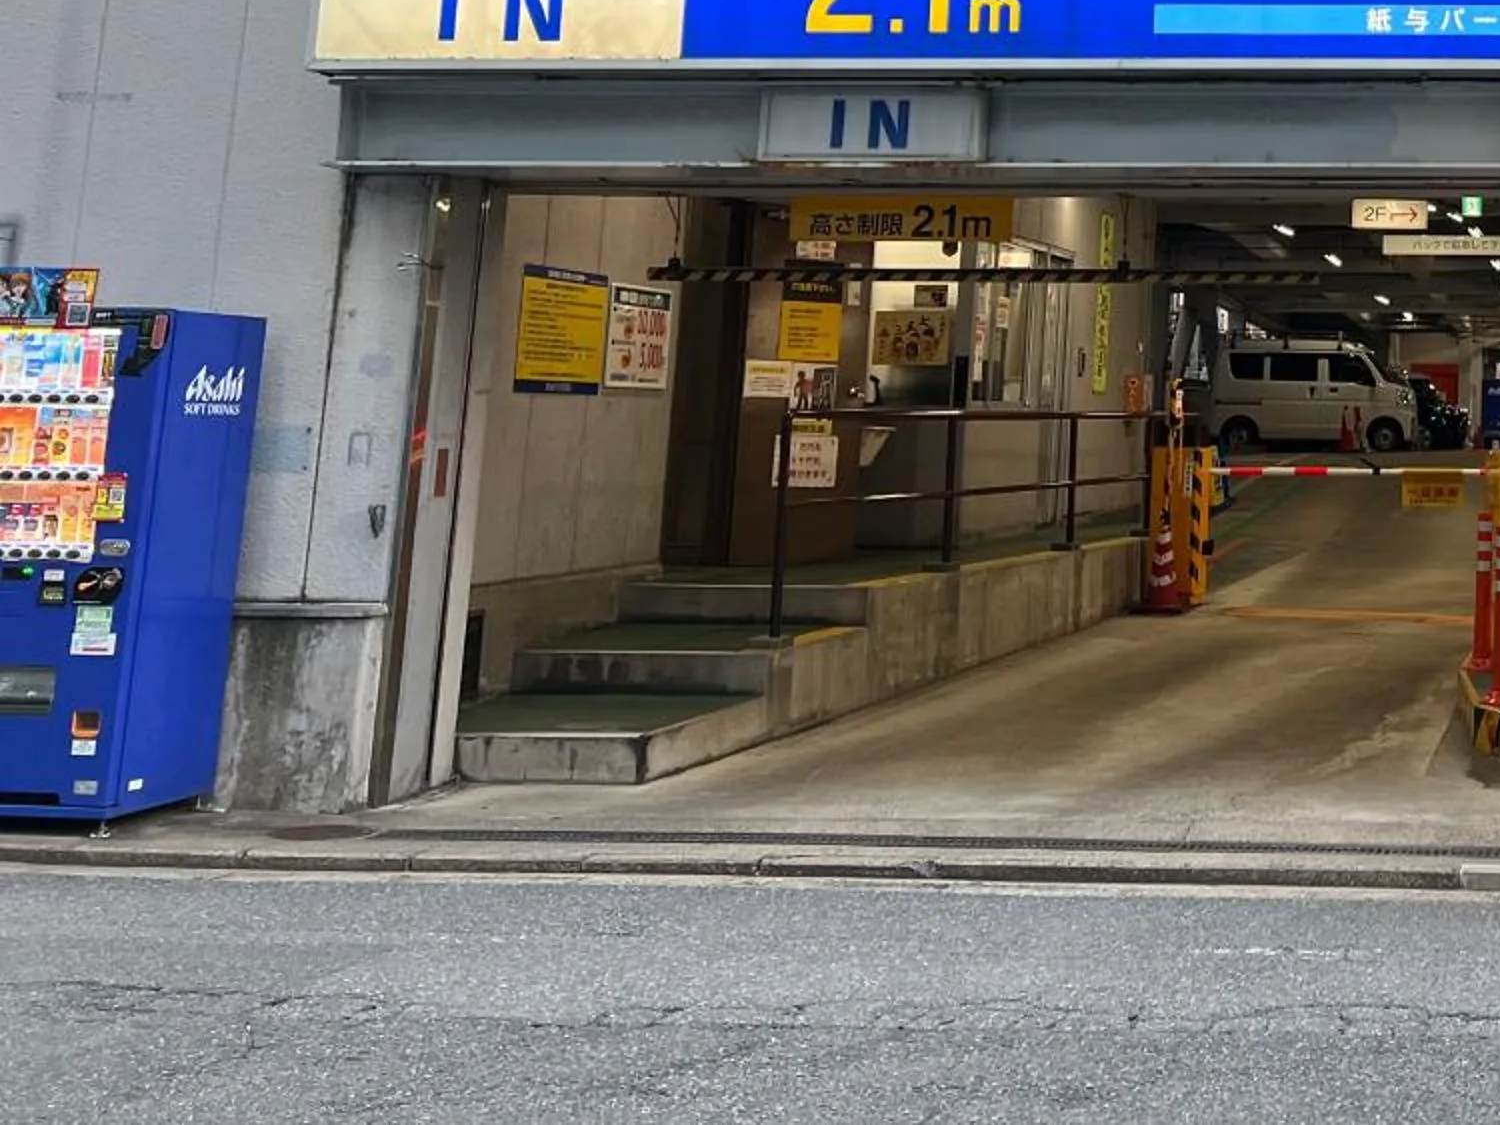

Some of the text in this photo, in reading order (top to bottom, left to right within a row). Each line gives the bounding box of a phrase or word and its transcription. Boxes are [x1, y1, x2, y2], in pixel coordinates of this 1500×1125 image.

[829, 98, 911, 149] IN
[809, 203, 993, 238] 高さ制限 2.1m
[1363, 206, 1388, 222] 2F
[185, 364, 246, 402] Asahi
[184, 402, 241, 416] SOFT DRINKS
